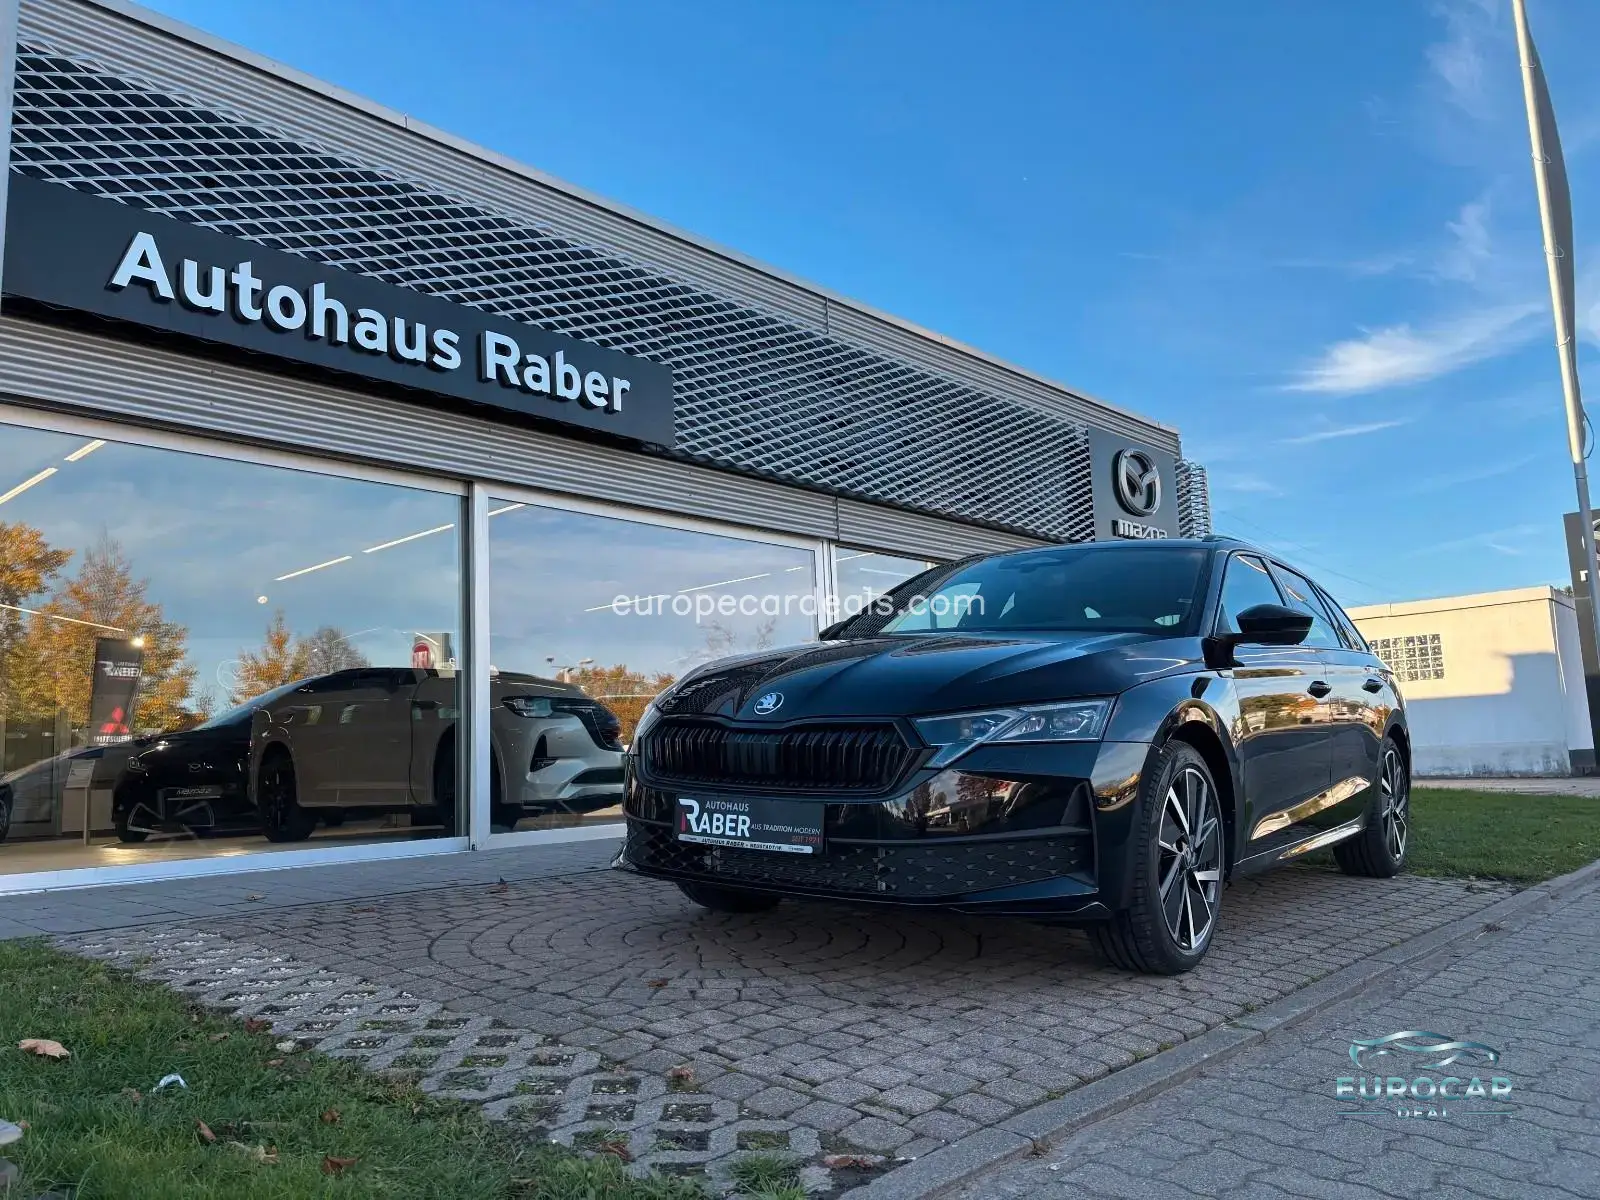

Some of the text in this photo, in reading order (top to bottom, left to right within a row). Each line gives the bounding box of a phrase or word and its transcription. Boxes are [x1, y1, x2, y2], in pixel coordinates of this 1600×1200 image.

[110, 231, 631, 413] Autohaus Raber
[678, 798, 751, 837] RABER
[705, 801, 750, 812] AUTOHAUS
[750, 823, 821, 835] AUS TRADITION MODERN
